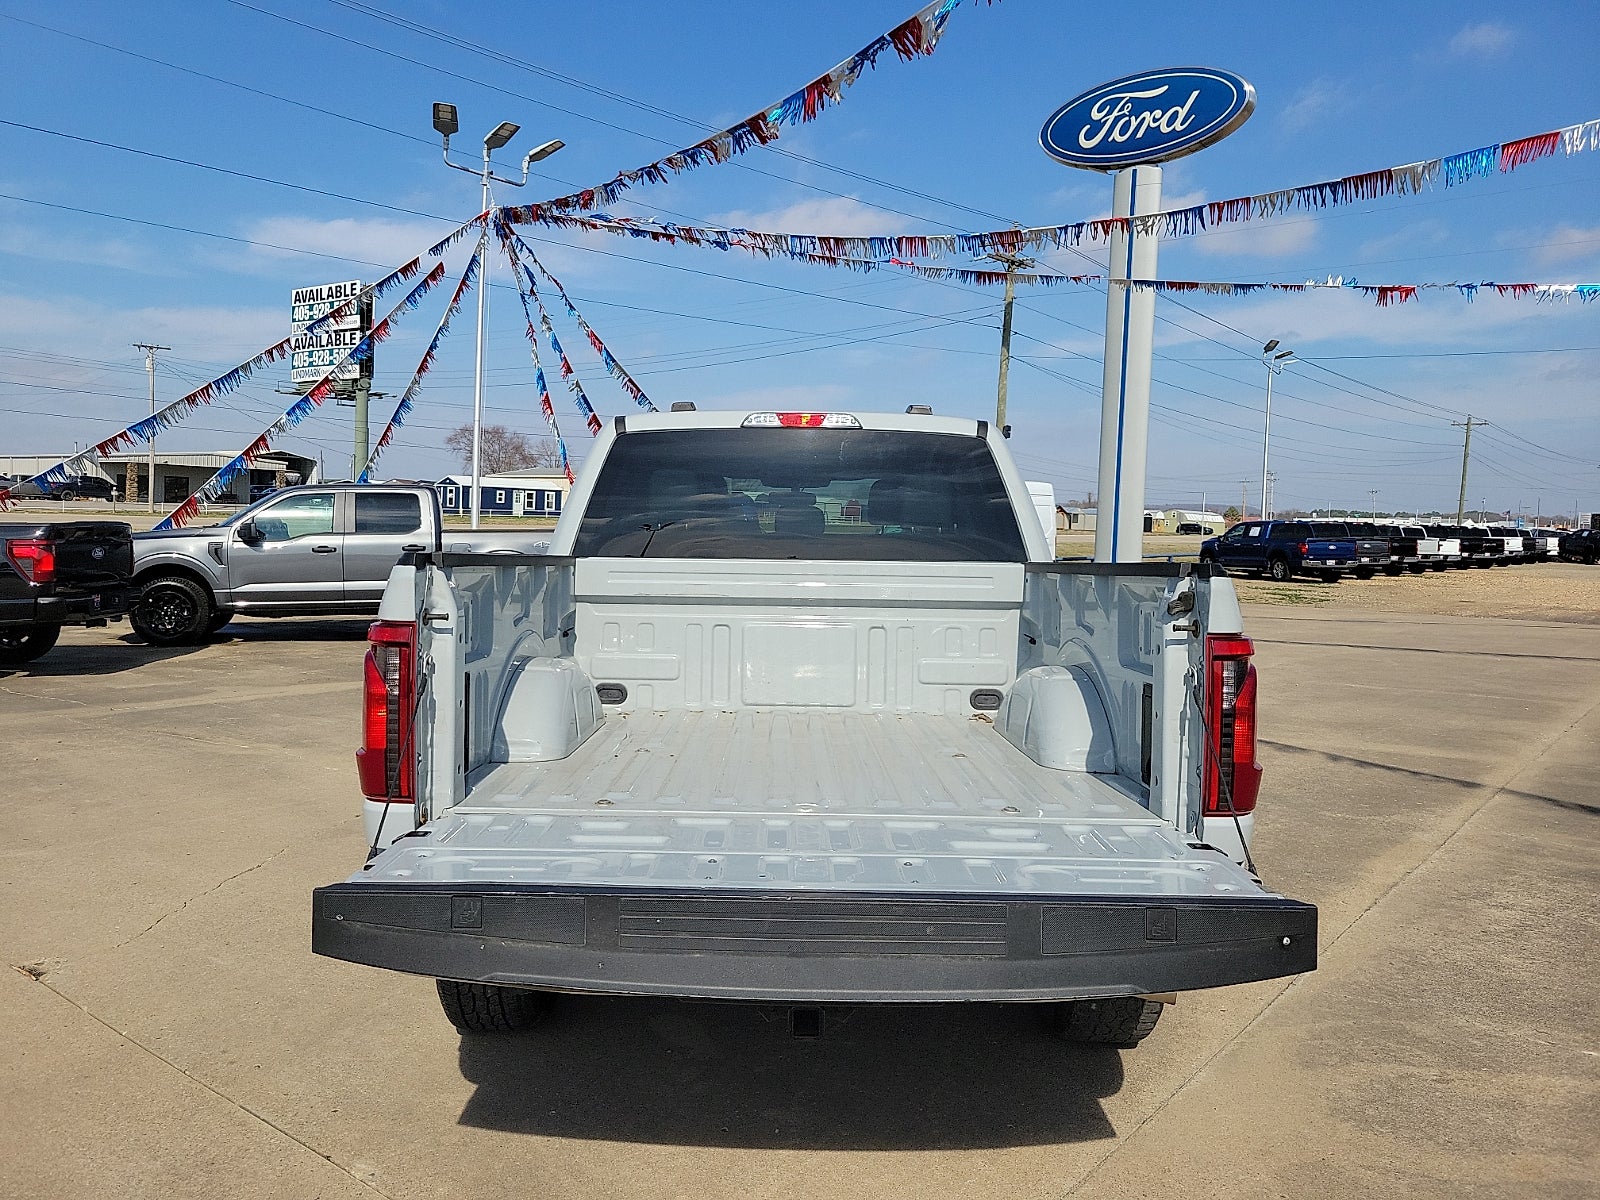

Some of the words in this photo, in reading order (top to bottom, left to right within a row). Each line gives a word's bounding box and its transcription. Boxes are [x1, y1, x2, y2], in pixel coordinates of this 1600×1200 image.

[1078, 84, 1201, 149] Ford
[294, 282, 357, 304] AVAILABLE
[294, 332, 357, 351] AVAILABLE
[292, 368, 321, 380] LINDMARK
